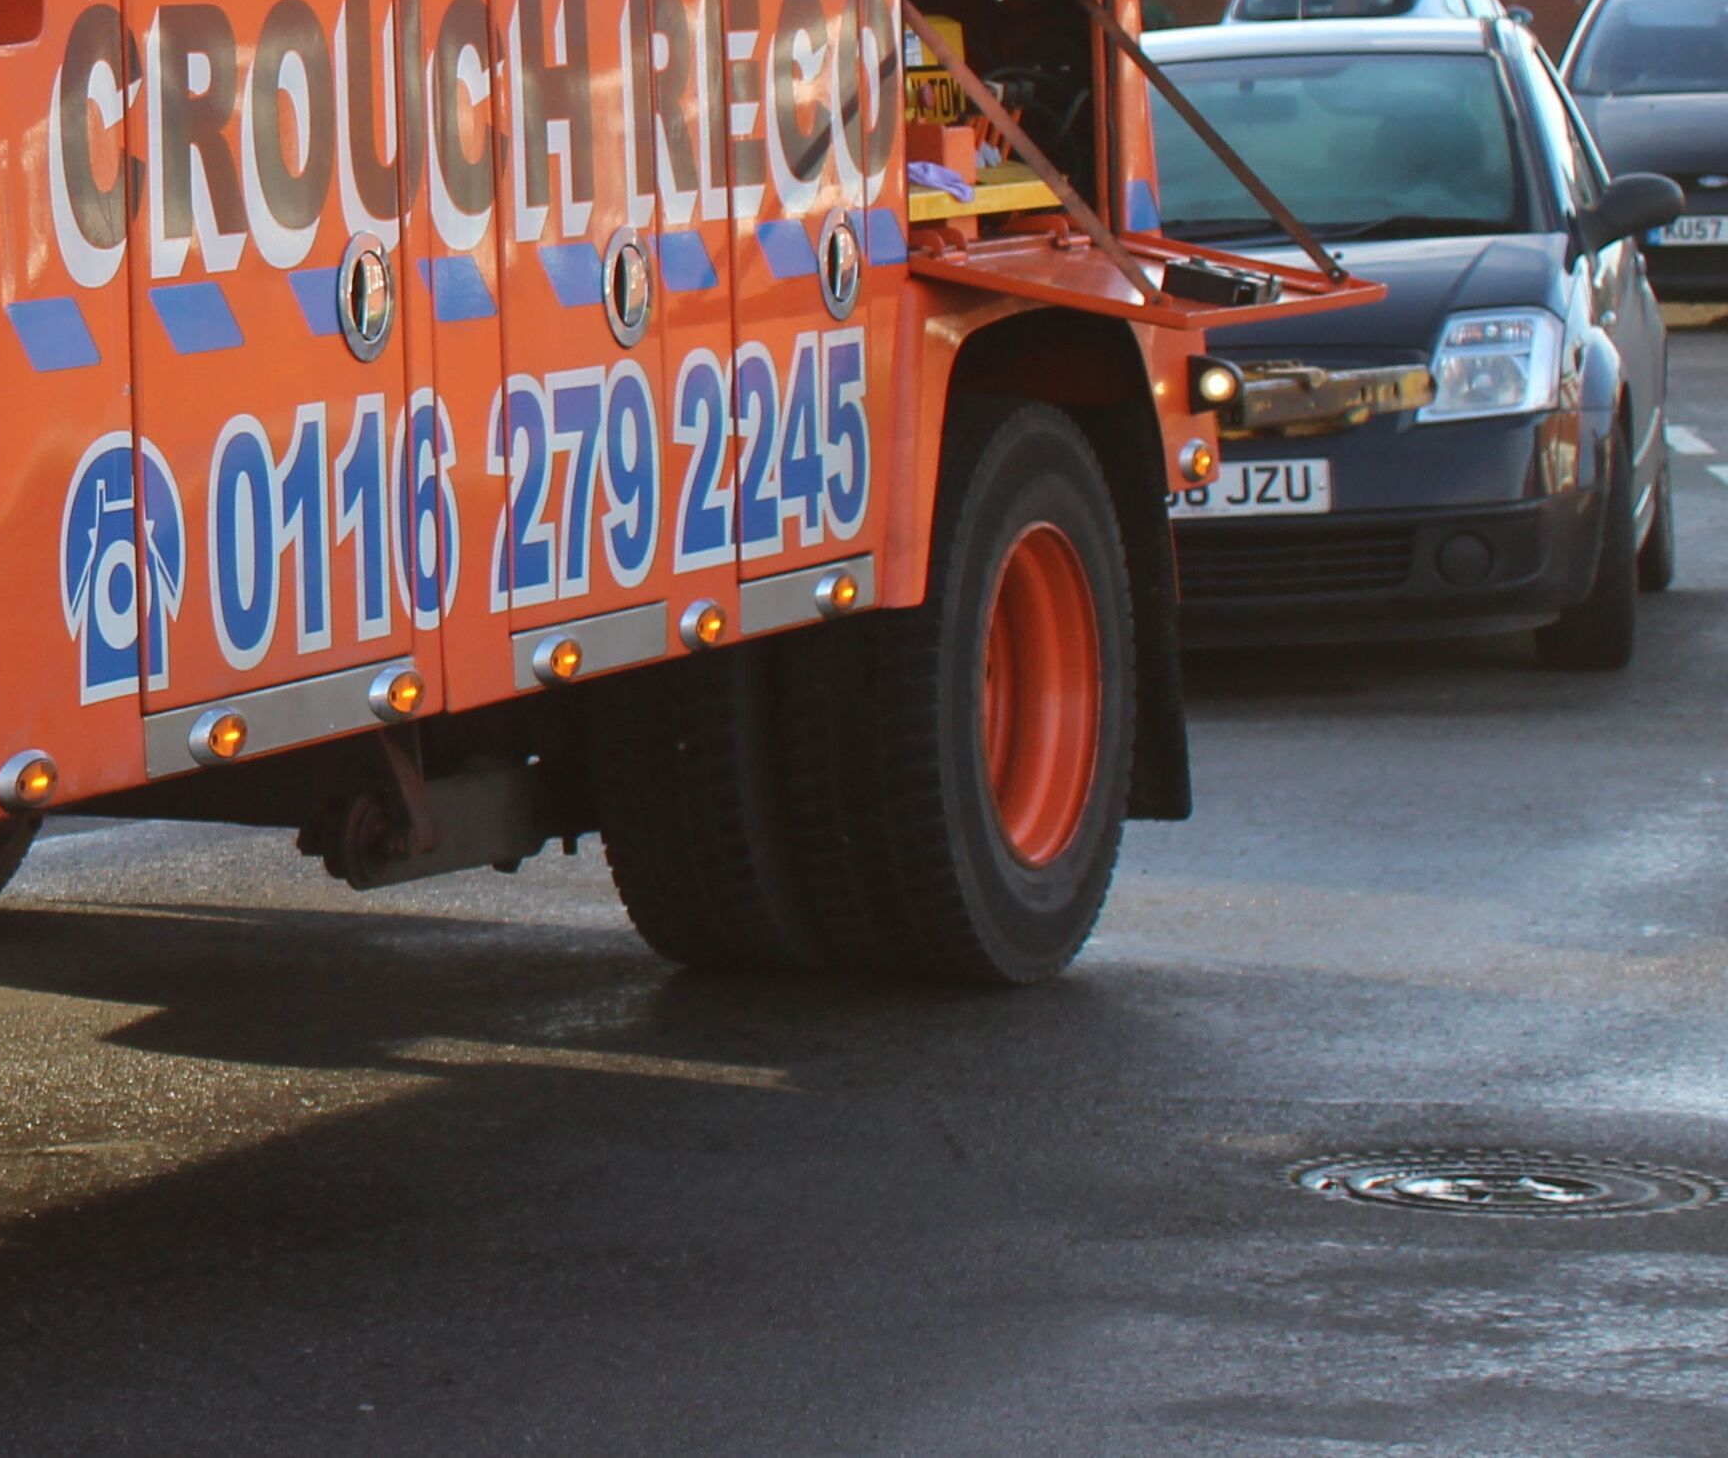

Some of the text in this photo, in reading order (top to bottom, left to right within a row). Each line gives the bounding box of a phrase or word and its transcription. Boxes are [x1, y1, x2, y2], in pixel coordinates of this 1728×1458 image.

[208, 326, 870, 671] 0116 279 2245
[1226, 465, 1312, 505] JZU
